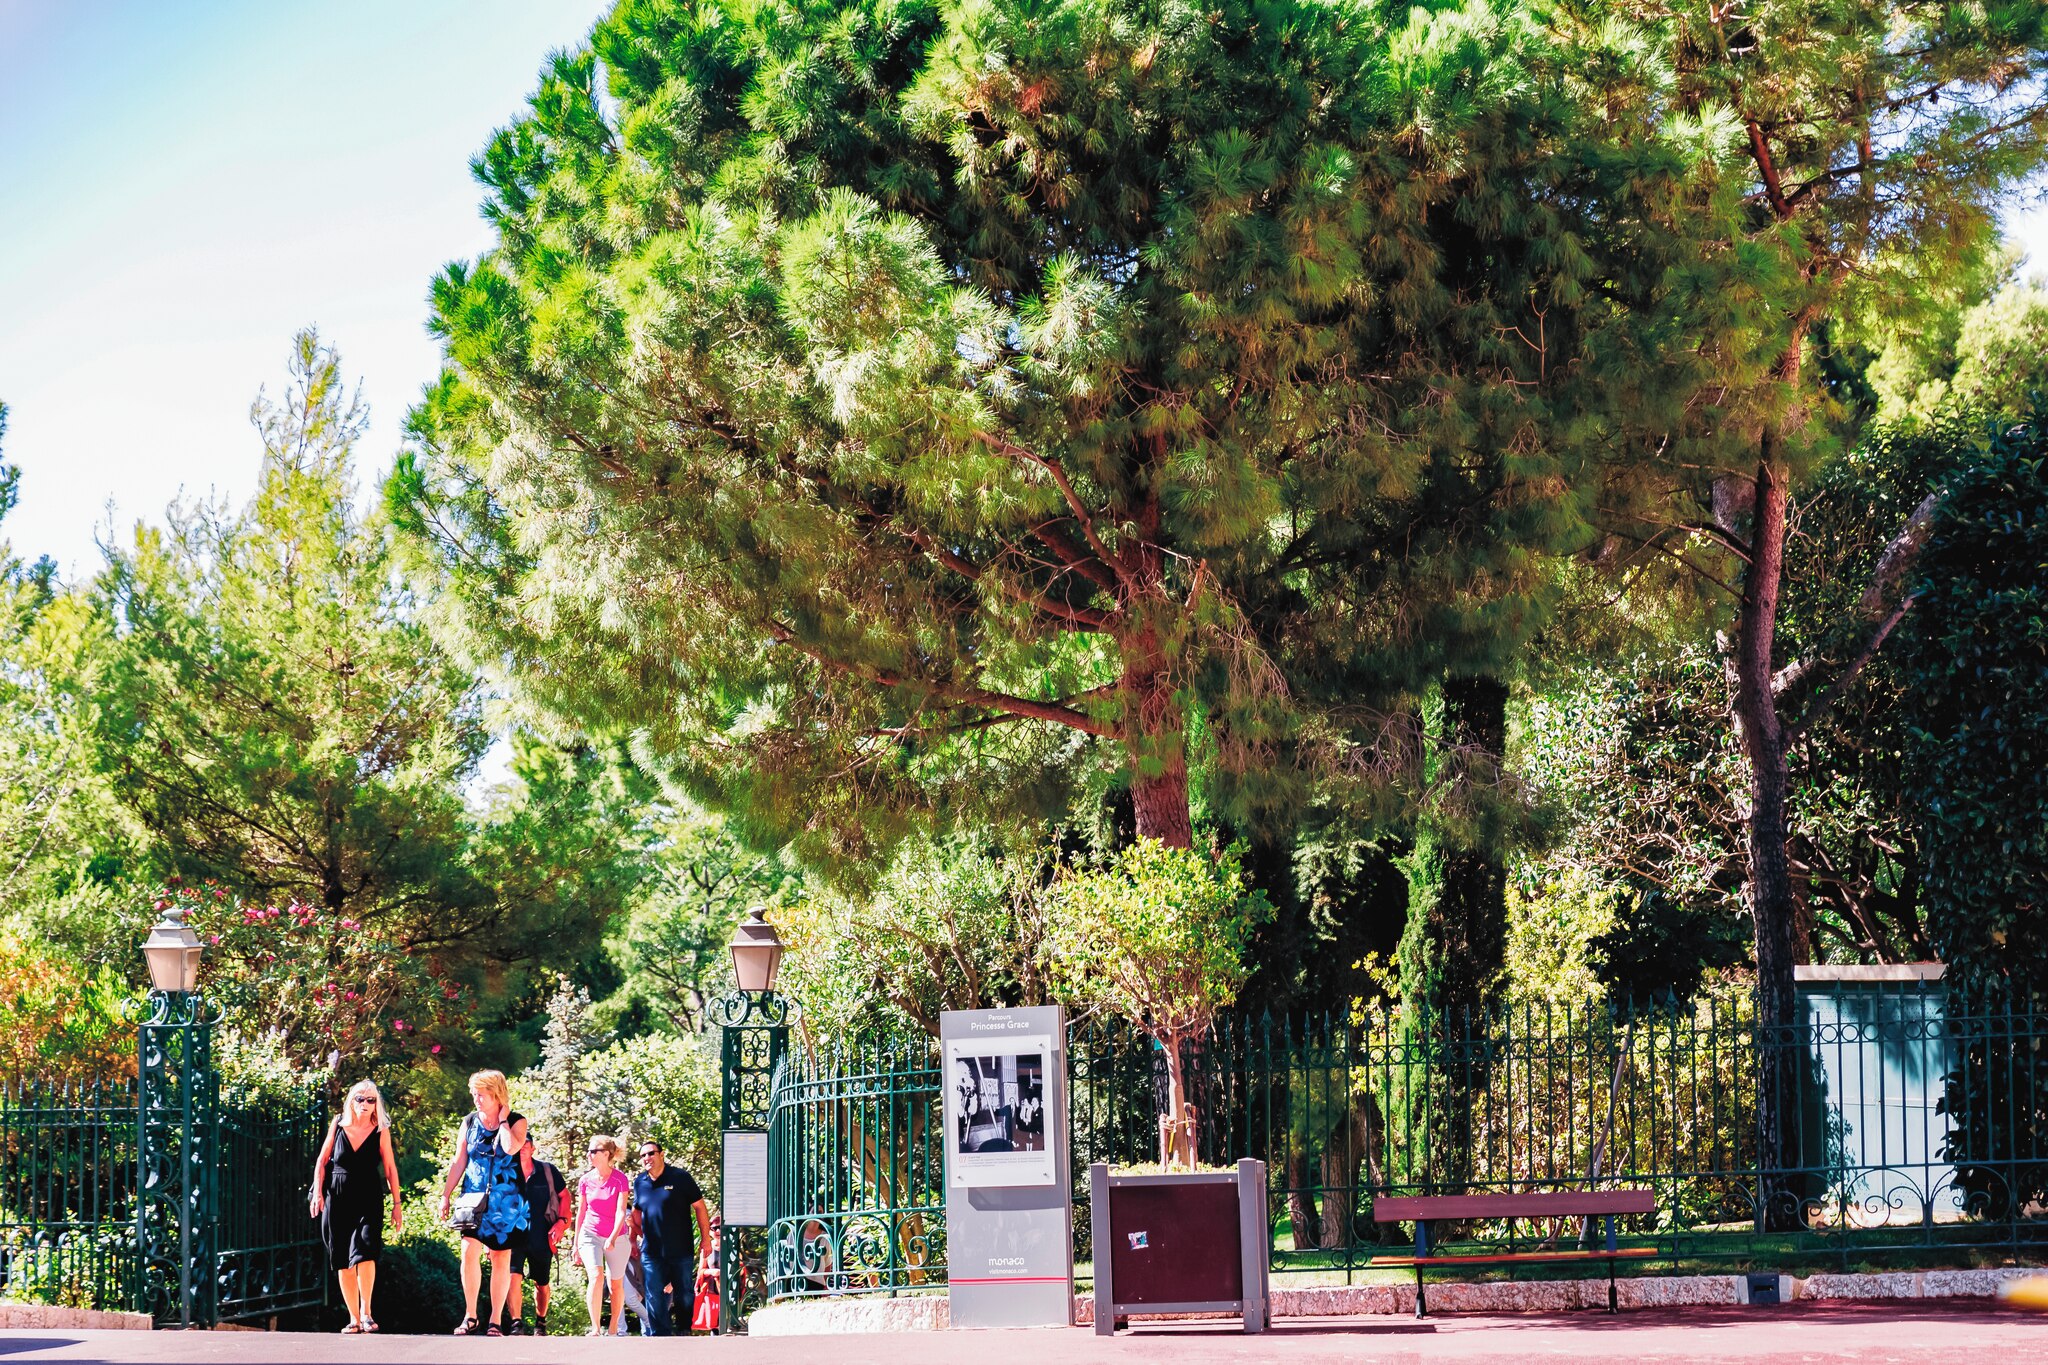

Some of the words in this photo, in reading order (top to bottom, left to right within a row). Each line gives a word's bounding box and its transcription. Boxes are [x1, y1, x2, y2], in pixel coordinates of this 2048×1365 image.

[971, 1022, 1005, 1031] Princesse
[1007, 1021, 1029, 1029] Grace
[988, 1257, 1025, 1266] monaco
